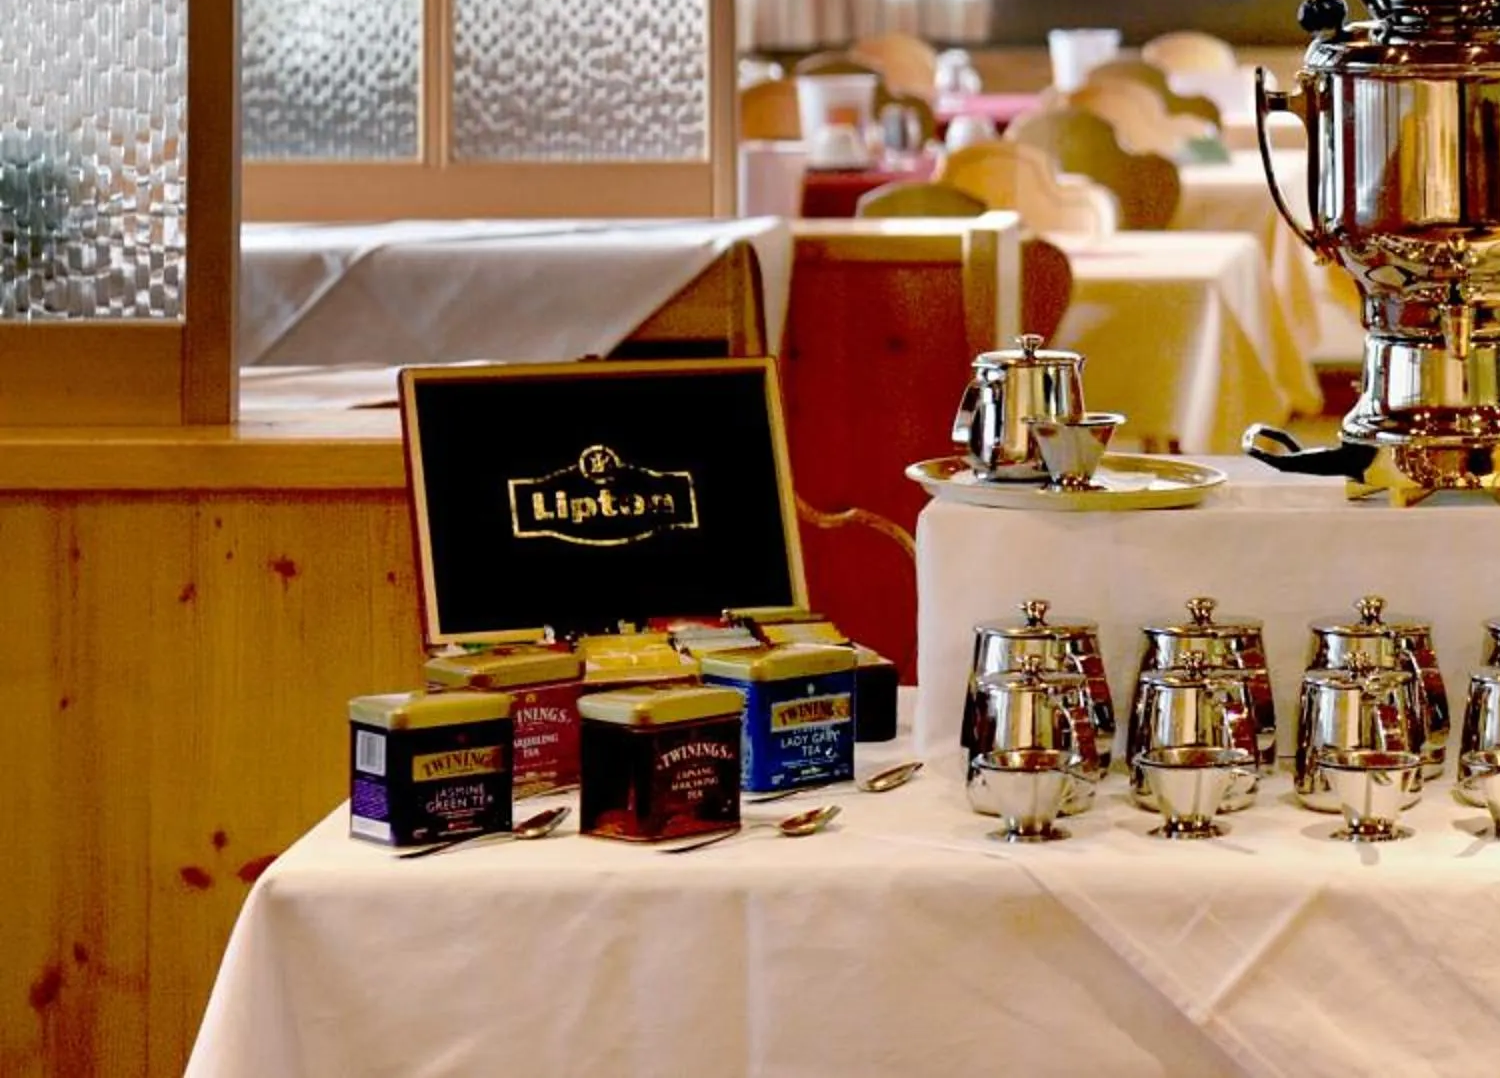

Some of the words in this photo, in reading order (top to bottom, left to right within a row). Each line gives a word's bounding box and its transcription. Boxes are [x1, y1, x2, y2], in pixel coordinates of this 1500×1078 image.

[532, 489, 675, 523] Lipton
[514, 706, 570, 726] ININGS
[660, 742, 728, 768] TWININGS
[801, 744, 821, 757] TEA
[420, 750, 498, 778] TWINING
[425, 795, 468, 813] GREEN
